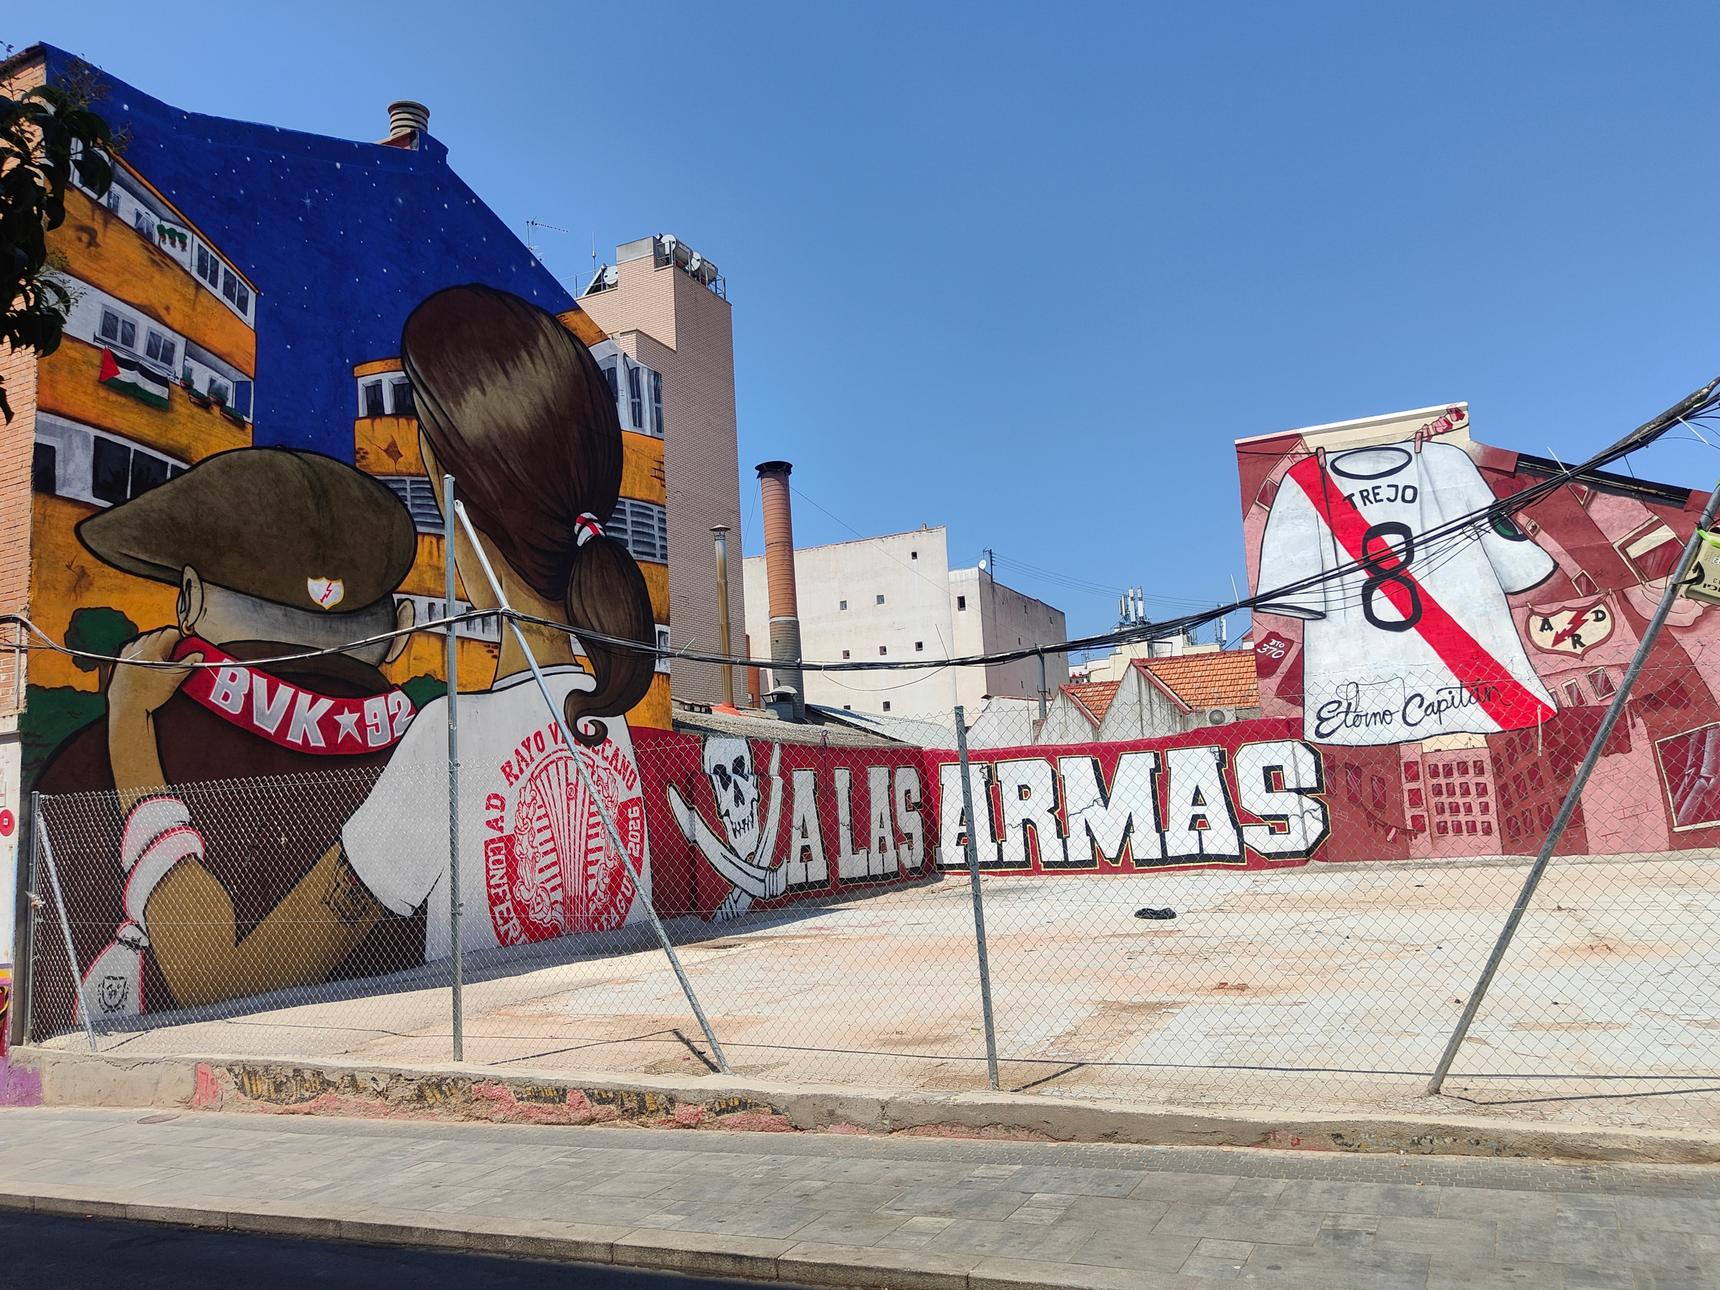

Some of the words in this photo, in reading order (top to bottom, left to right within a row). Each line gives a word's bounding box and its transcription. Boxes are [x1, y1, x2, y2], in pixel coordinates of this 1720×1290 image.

[1343, 484, 1418, 510] TREJO
[1362, 521, 1423, 632] 8
[1256, 643, 1285, 659] 370
[209, 658, 335, 747] BVK
[363, 689, 415, 747] 92
[1314, 682, 1400, 739] Eterno
[484, 792, 506, 834] AD
[500, 730, 546, 788] RAYO
[786, 767, 830, 891] A
[834, 766, 925, 885] LAS
[935, 740, 1331, 870] ARMAS
[627, 806, 641, 858] 2026
